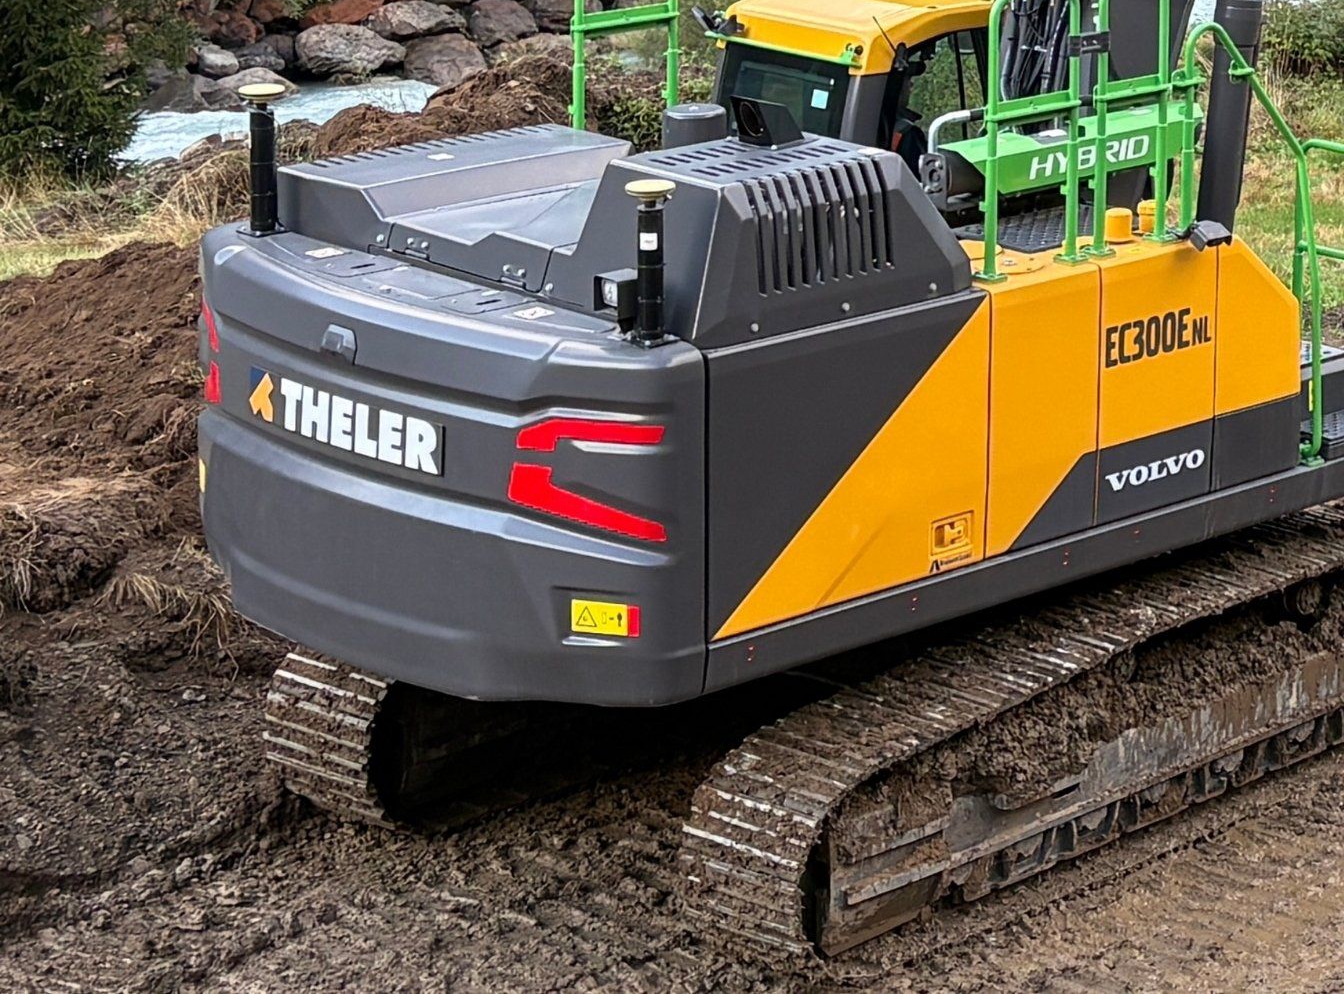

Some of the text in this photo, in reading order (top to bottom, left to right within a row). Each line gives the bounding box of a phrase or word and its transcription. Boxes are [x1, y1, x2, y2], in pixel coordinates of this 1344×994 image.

[1029, 135, 1149, 180] HYBRID
[280, 377, 438, 475] THELER
[1105, 449, 1205, 492] VOLVO
